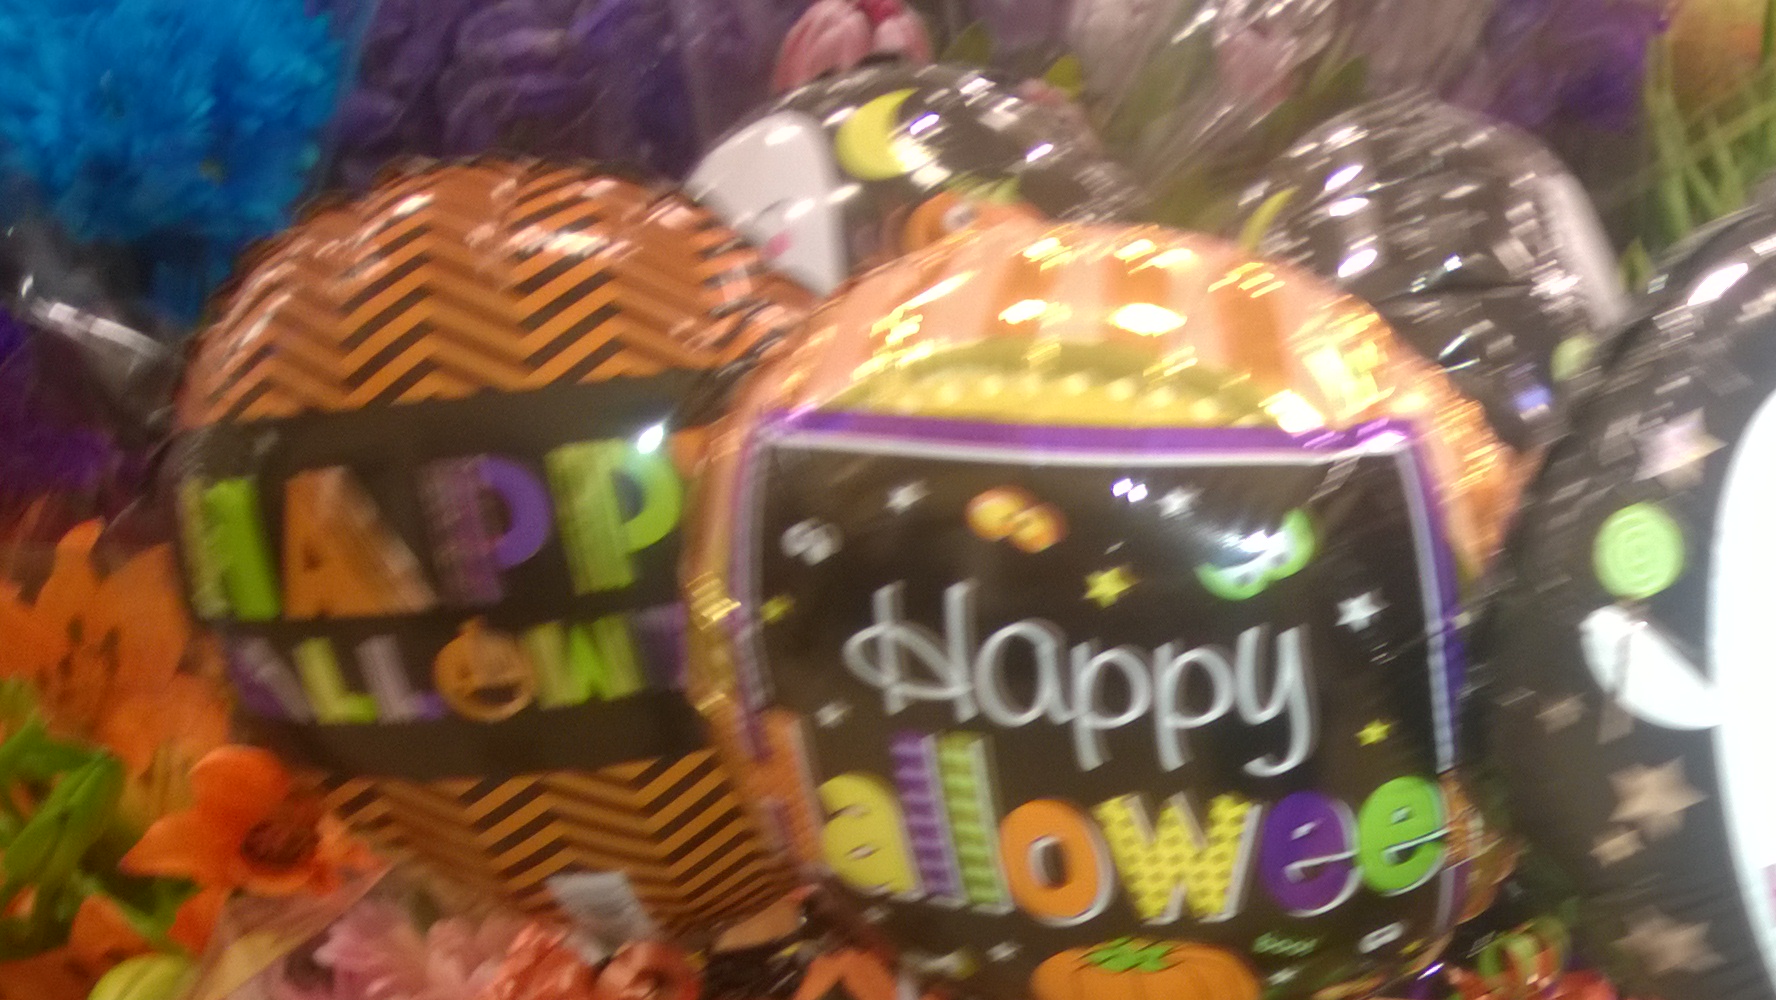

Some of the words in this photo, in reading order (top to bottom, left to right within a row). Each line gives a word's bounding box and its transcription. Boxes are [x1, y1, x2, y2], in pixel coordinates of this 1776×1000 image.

[178, 436, 700, 622] HAPP
[843, 580, 1318, 778] Happy
[795, 727, 1476, 928] allowee
